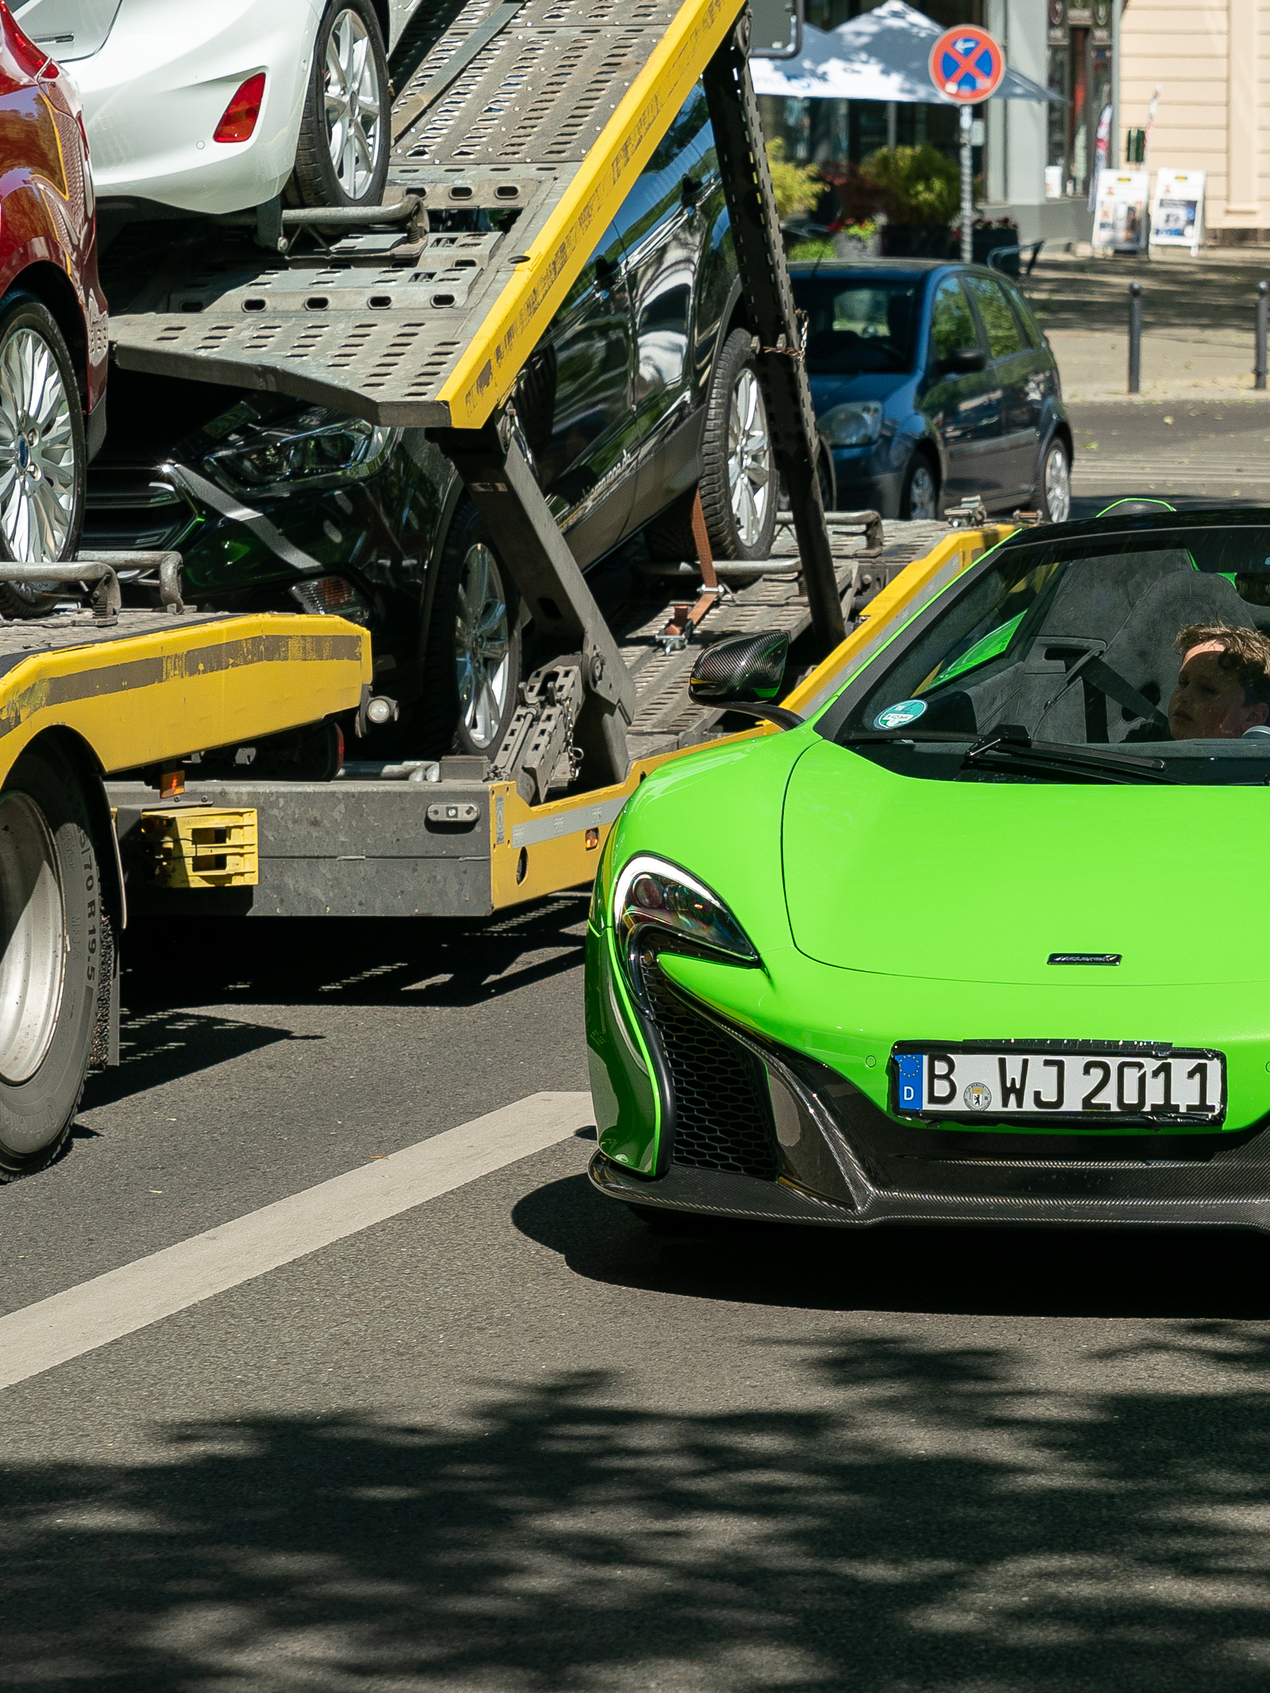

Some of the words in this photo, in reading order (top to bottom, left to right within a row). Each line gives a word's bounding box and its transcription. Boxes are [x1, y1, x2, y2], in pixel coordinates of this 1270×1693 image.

[87, 898, 96, 919] R
[903, 1086, 915, 1101] D
[926, 1054, 957, 1105] B
[998, 1056, 1065, 1110] WJ
[1081, 1060, 1216, 1113] 2011
